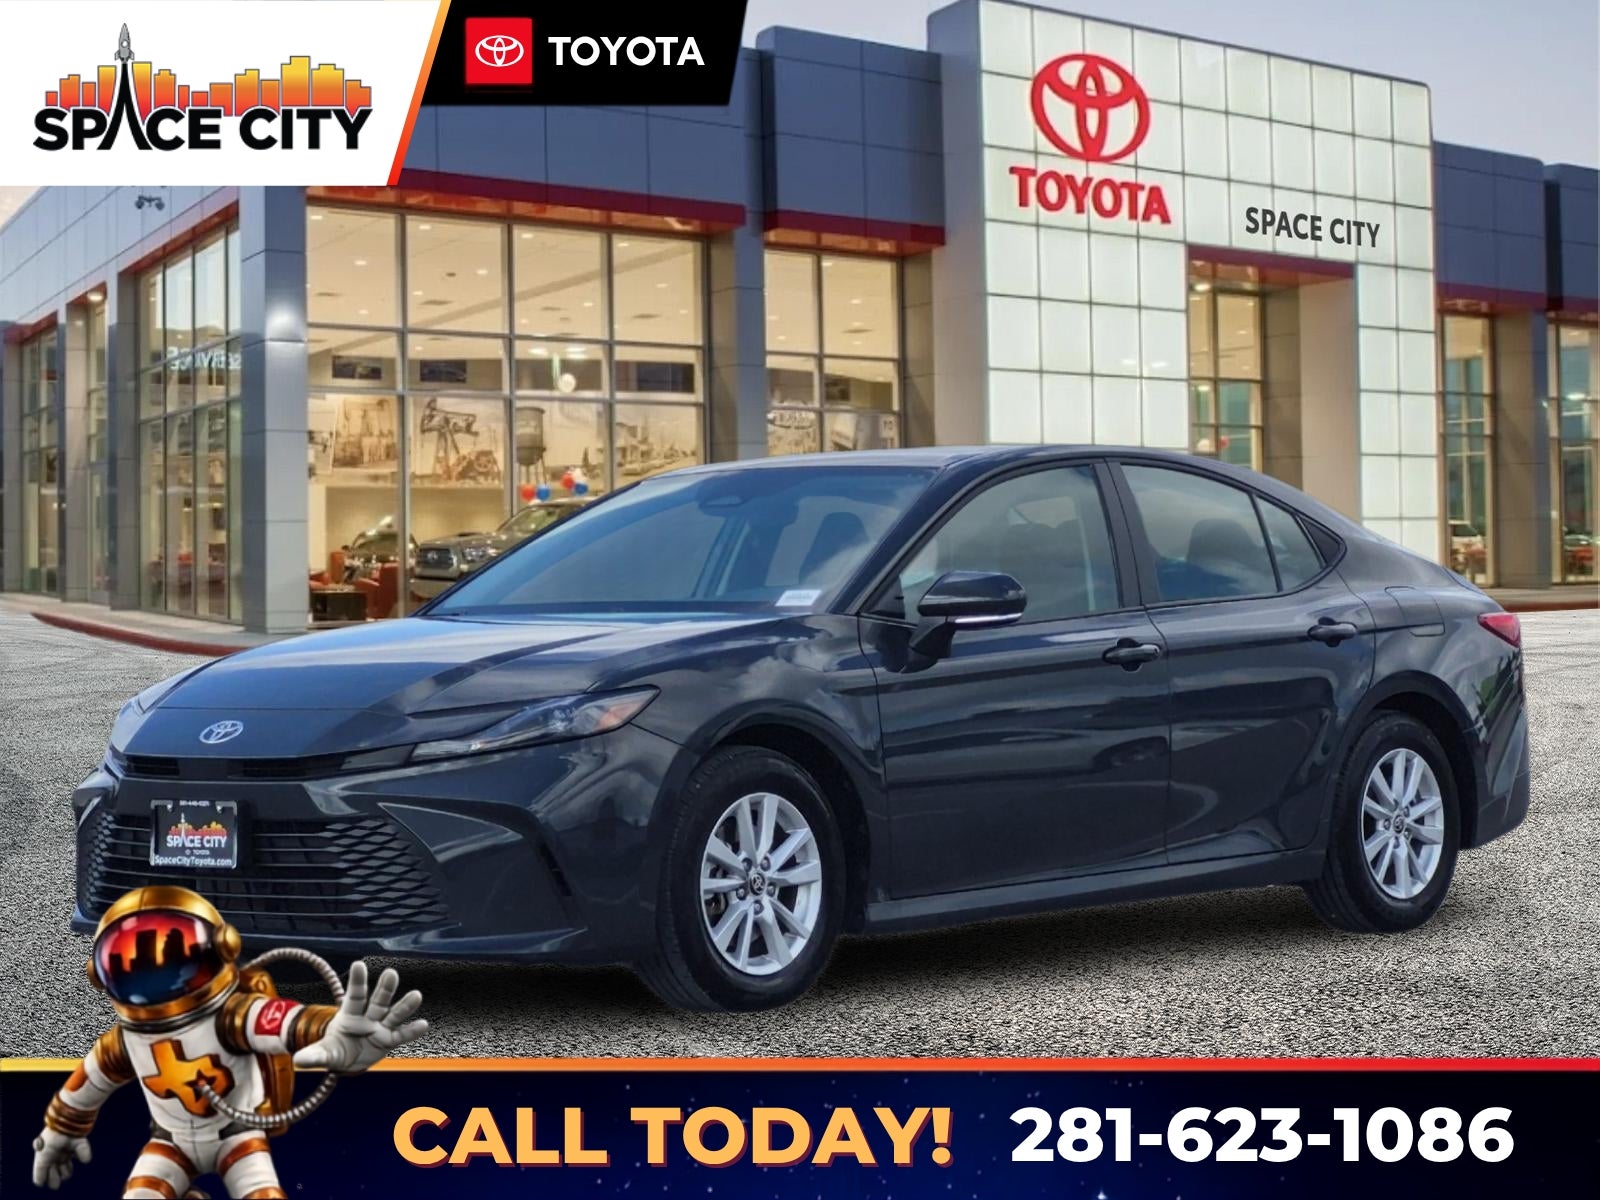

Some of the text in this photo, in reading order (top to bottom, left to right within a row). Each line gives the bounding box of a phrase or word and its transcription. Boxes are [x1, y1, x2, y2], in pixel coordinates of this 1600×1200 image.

[1009, 166, 1172, 224] TOYOTA
[1245, 206, 1381, 248] SPACE CITY
[166, 834, 227, 848] SPACE CITY
[154, 854, 233, 866] SpaceCityToyota.com
